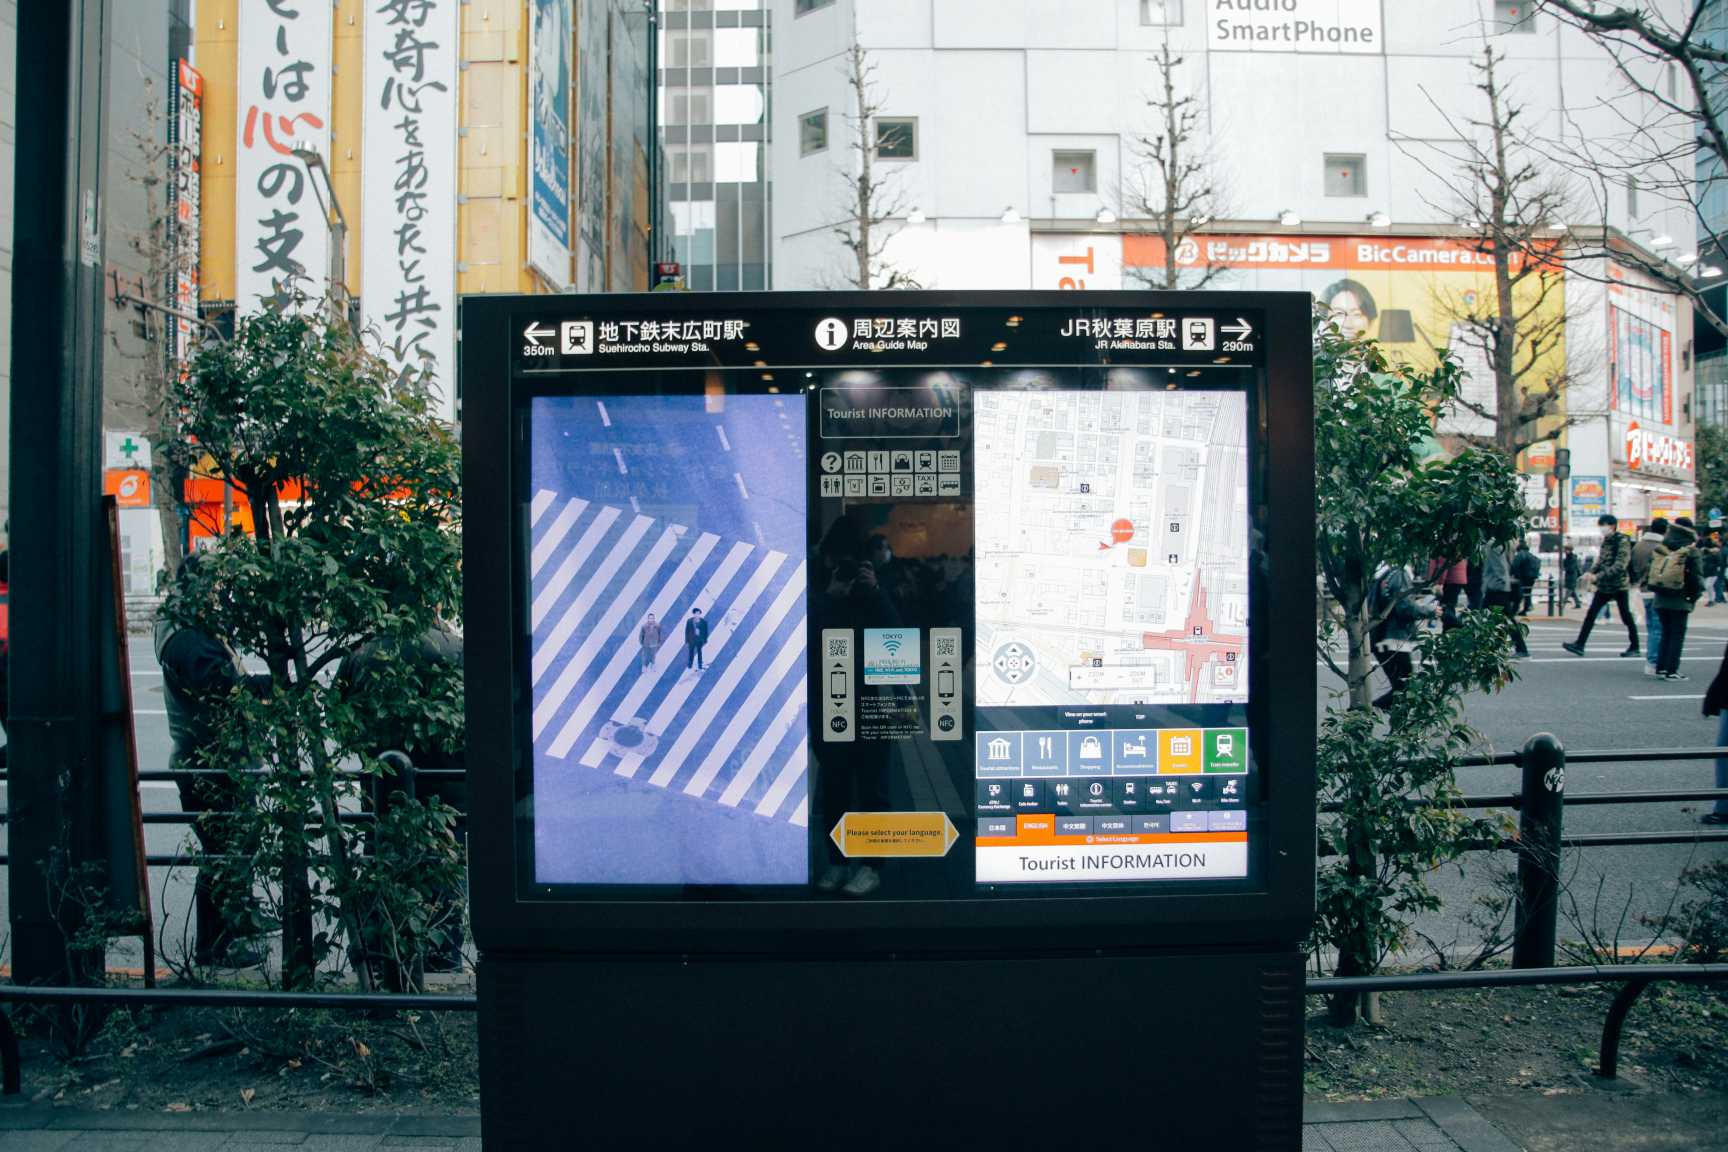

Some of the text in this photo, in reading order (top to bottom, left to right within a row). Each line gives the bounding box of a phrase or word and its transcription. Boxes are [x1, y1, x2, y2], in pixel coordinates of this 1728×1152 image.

[1206, 240, 1329, 263] ビックカメラ
[598, 319, 744, 341] 地下鉄末広町駅
[852, 317, 960, 339] 周辺案内図
[1060, 317, 1176, 339] JR秋葉原駅
[523, 343, 555, 357] 350m
[598, 342, 710, 355] Suehirocho Subway Sta.
[852, 339, 928, 352] Area Guide Map
[1095, 339, 1176, 350] JR Akihabara Sta.
[1222, 340, 1254, 352] 290m
[828, 407, 952, 419] Tourist INFORMATION
[939, 719, 953, 729] NFC
[847, 829, 941, 839] Please select your language
[1019, 853, 1206, 872] Tourist INFORMATION
